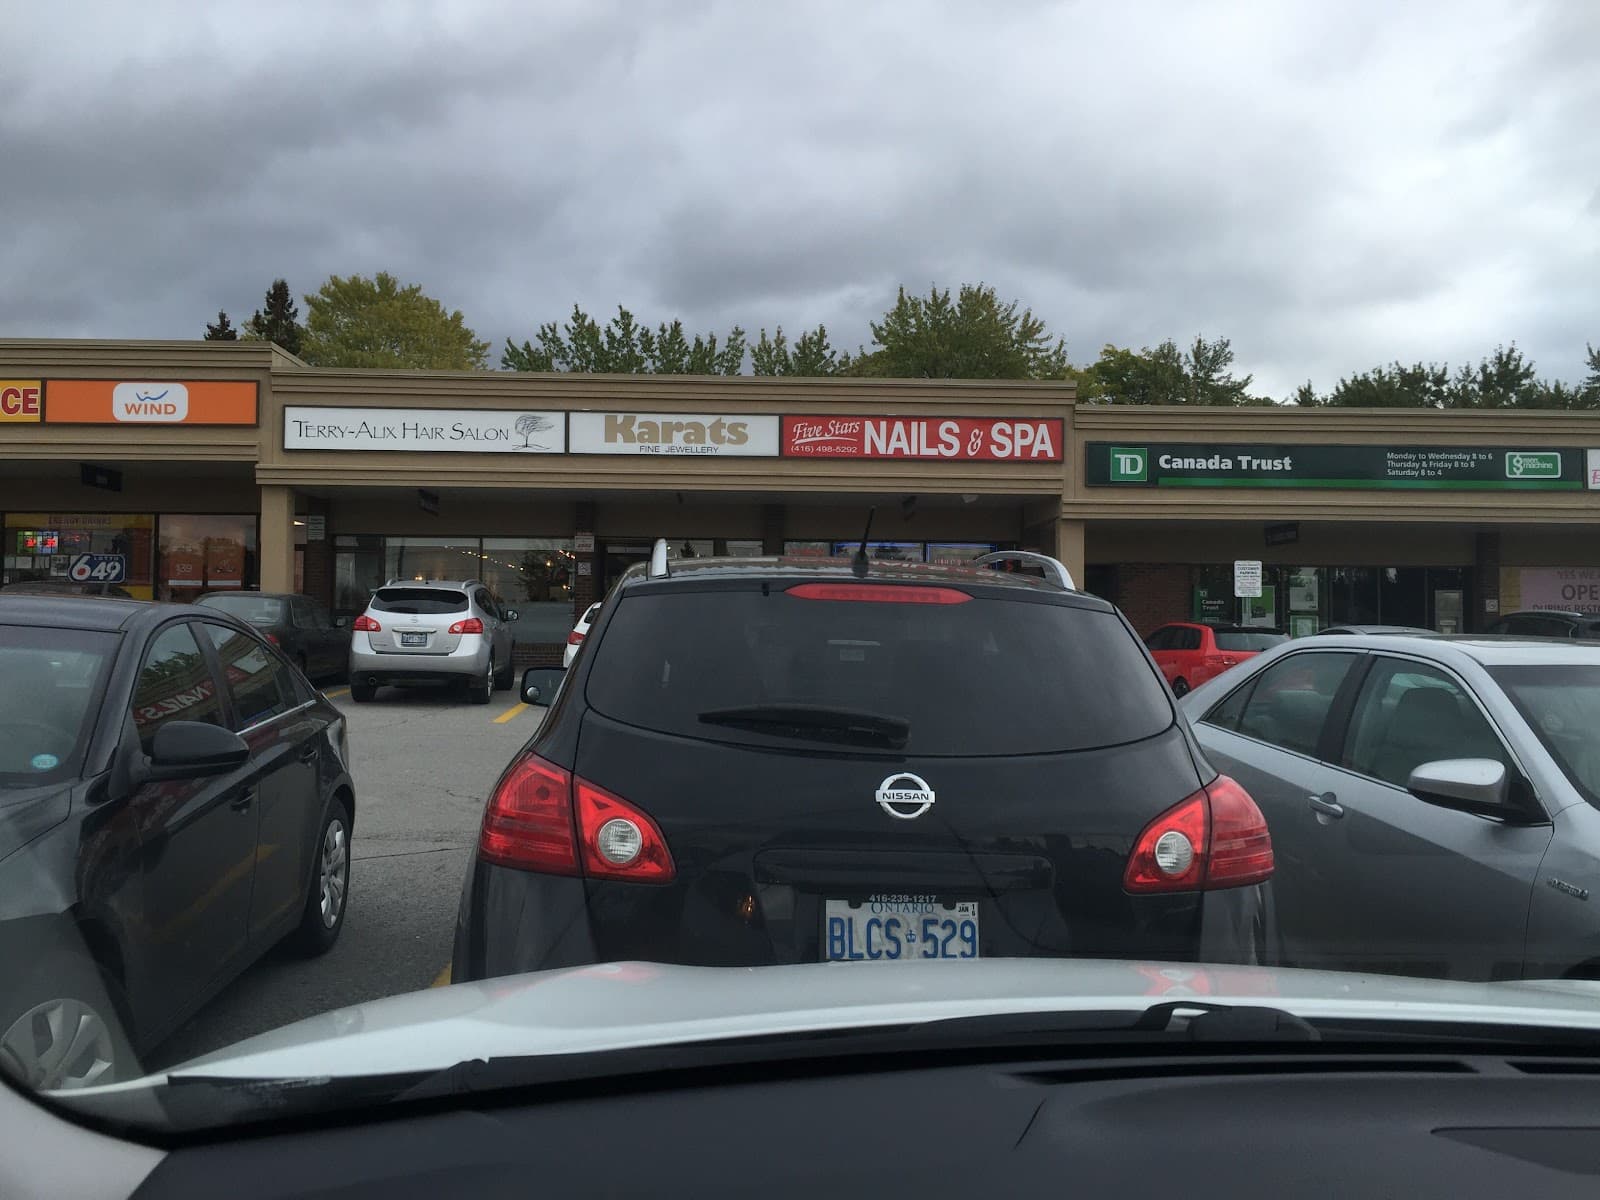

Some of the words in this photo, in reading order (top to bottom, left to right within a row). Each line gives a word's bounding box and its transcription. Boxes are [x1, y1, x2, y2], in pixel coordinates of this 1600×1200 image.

[124, 403, 177, 415] WIND
[402, 422, 445, 441] HAIR
[449, 422, 509, 441] SALON
[604, 415, 749, 446] Karats
[792, 422, 822, 442] Five
[825, 420, 860, 437] Stars
[864, 421, 961, 457] NAILS
[967, 428, 983, 457] &
[990, 421, 1054, 458] SPA
[665, 446, 719, 454] JEWELLERY
[791, 446, 814, 454] (416)
[1386, 452, 1417, 461] Monday
[1418, 452, 1427, 460] to
[1428, 452, 1471, 461] Wednesday
[1114, 454, 1143, 475] TD
[1158, 455, 1233, 470] Canada
[1237, 455, 1292, 471] Trust
[1387, 460, 1420, 469] Thursday
[1429, 461, 1452, 469] Friday
[1387, 468, 1419, 477] Saturday
[882, 792, 929, 801] NISSAN
[871, 903, 935, 914] ONTARIO
[829, 916, 901, 960] BLCS
[922, 918, 977, 959] 529
